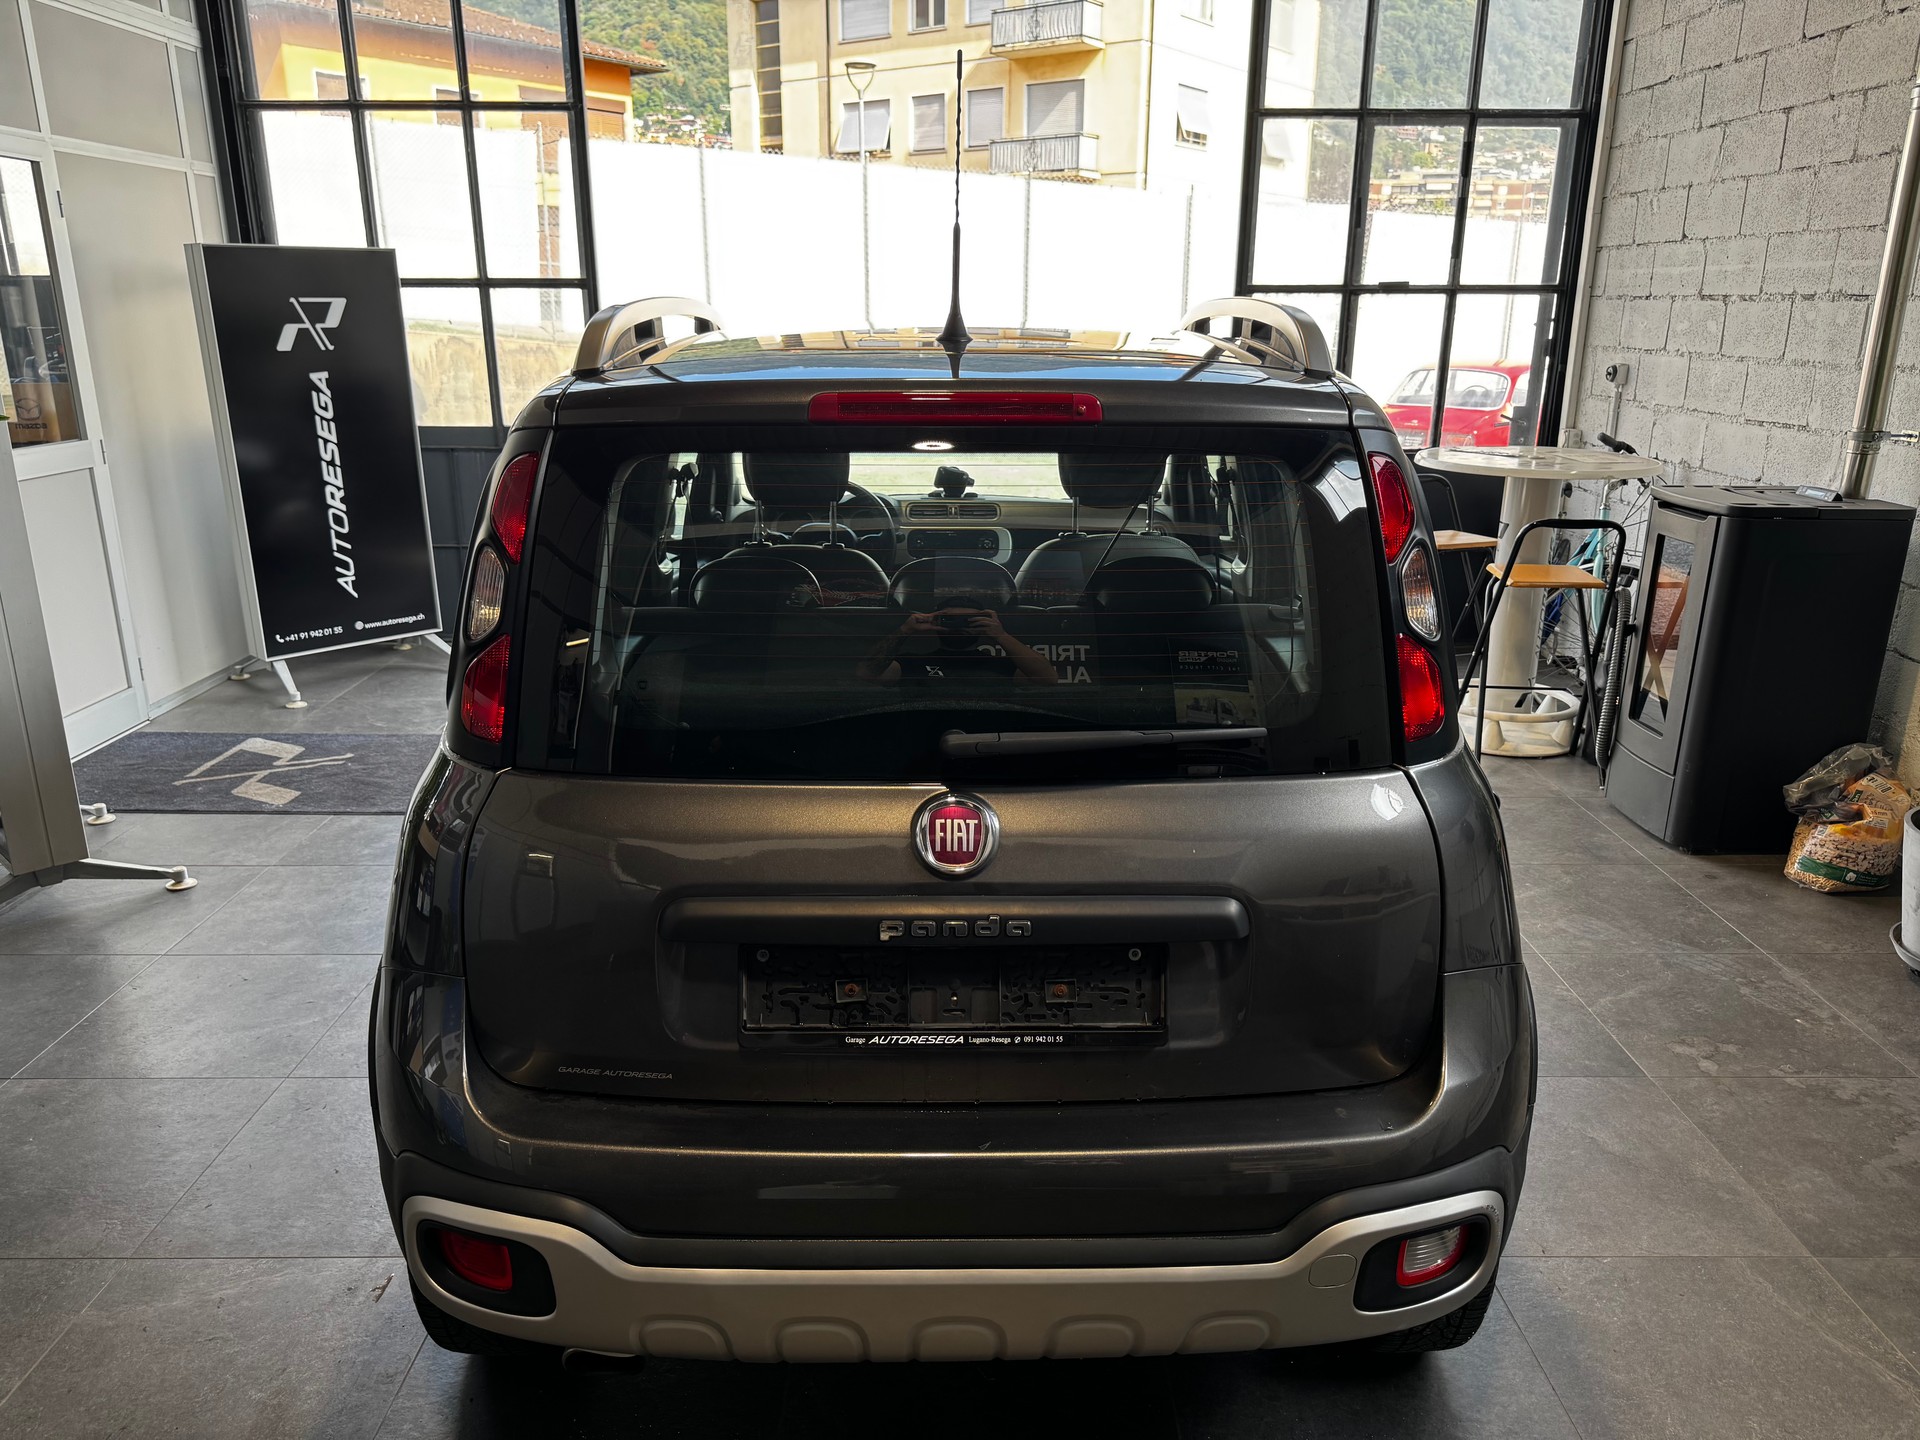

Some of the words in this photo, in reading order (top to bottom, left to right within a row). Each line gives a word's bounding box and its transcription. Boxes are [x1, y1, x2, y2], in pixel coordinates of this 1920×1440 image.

[309, 371, 359, 599] AUTORESEGA
[365, 613, 426, 629] www.autoresega.ch
[285, 633, 299, 642] +41
[300, 631, 309, 640] 91
[311, 630, 324, 639] 942
[325, 628, 333, 636] 01
[334, 626, 343, 635] 55
[935, 818, 979, 852] FIAT
[879, 914, 1032, 941] panda
[845, 1036, 866, 1045] Garage
[868, 1035, 964, 1044] AUTORESEGA
[968, 1036, 1011, 1045] Lugano-Resega
[558, 1066, 601, 1075] GARAGE
[602, 1070, 673, 1080] AUTORESEGA
